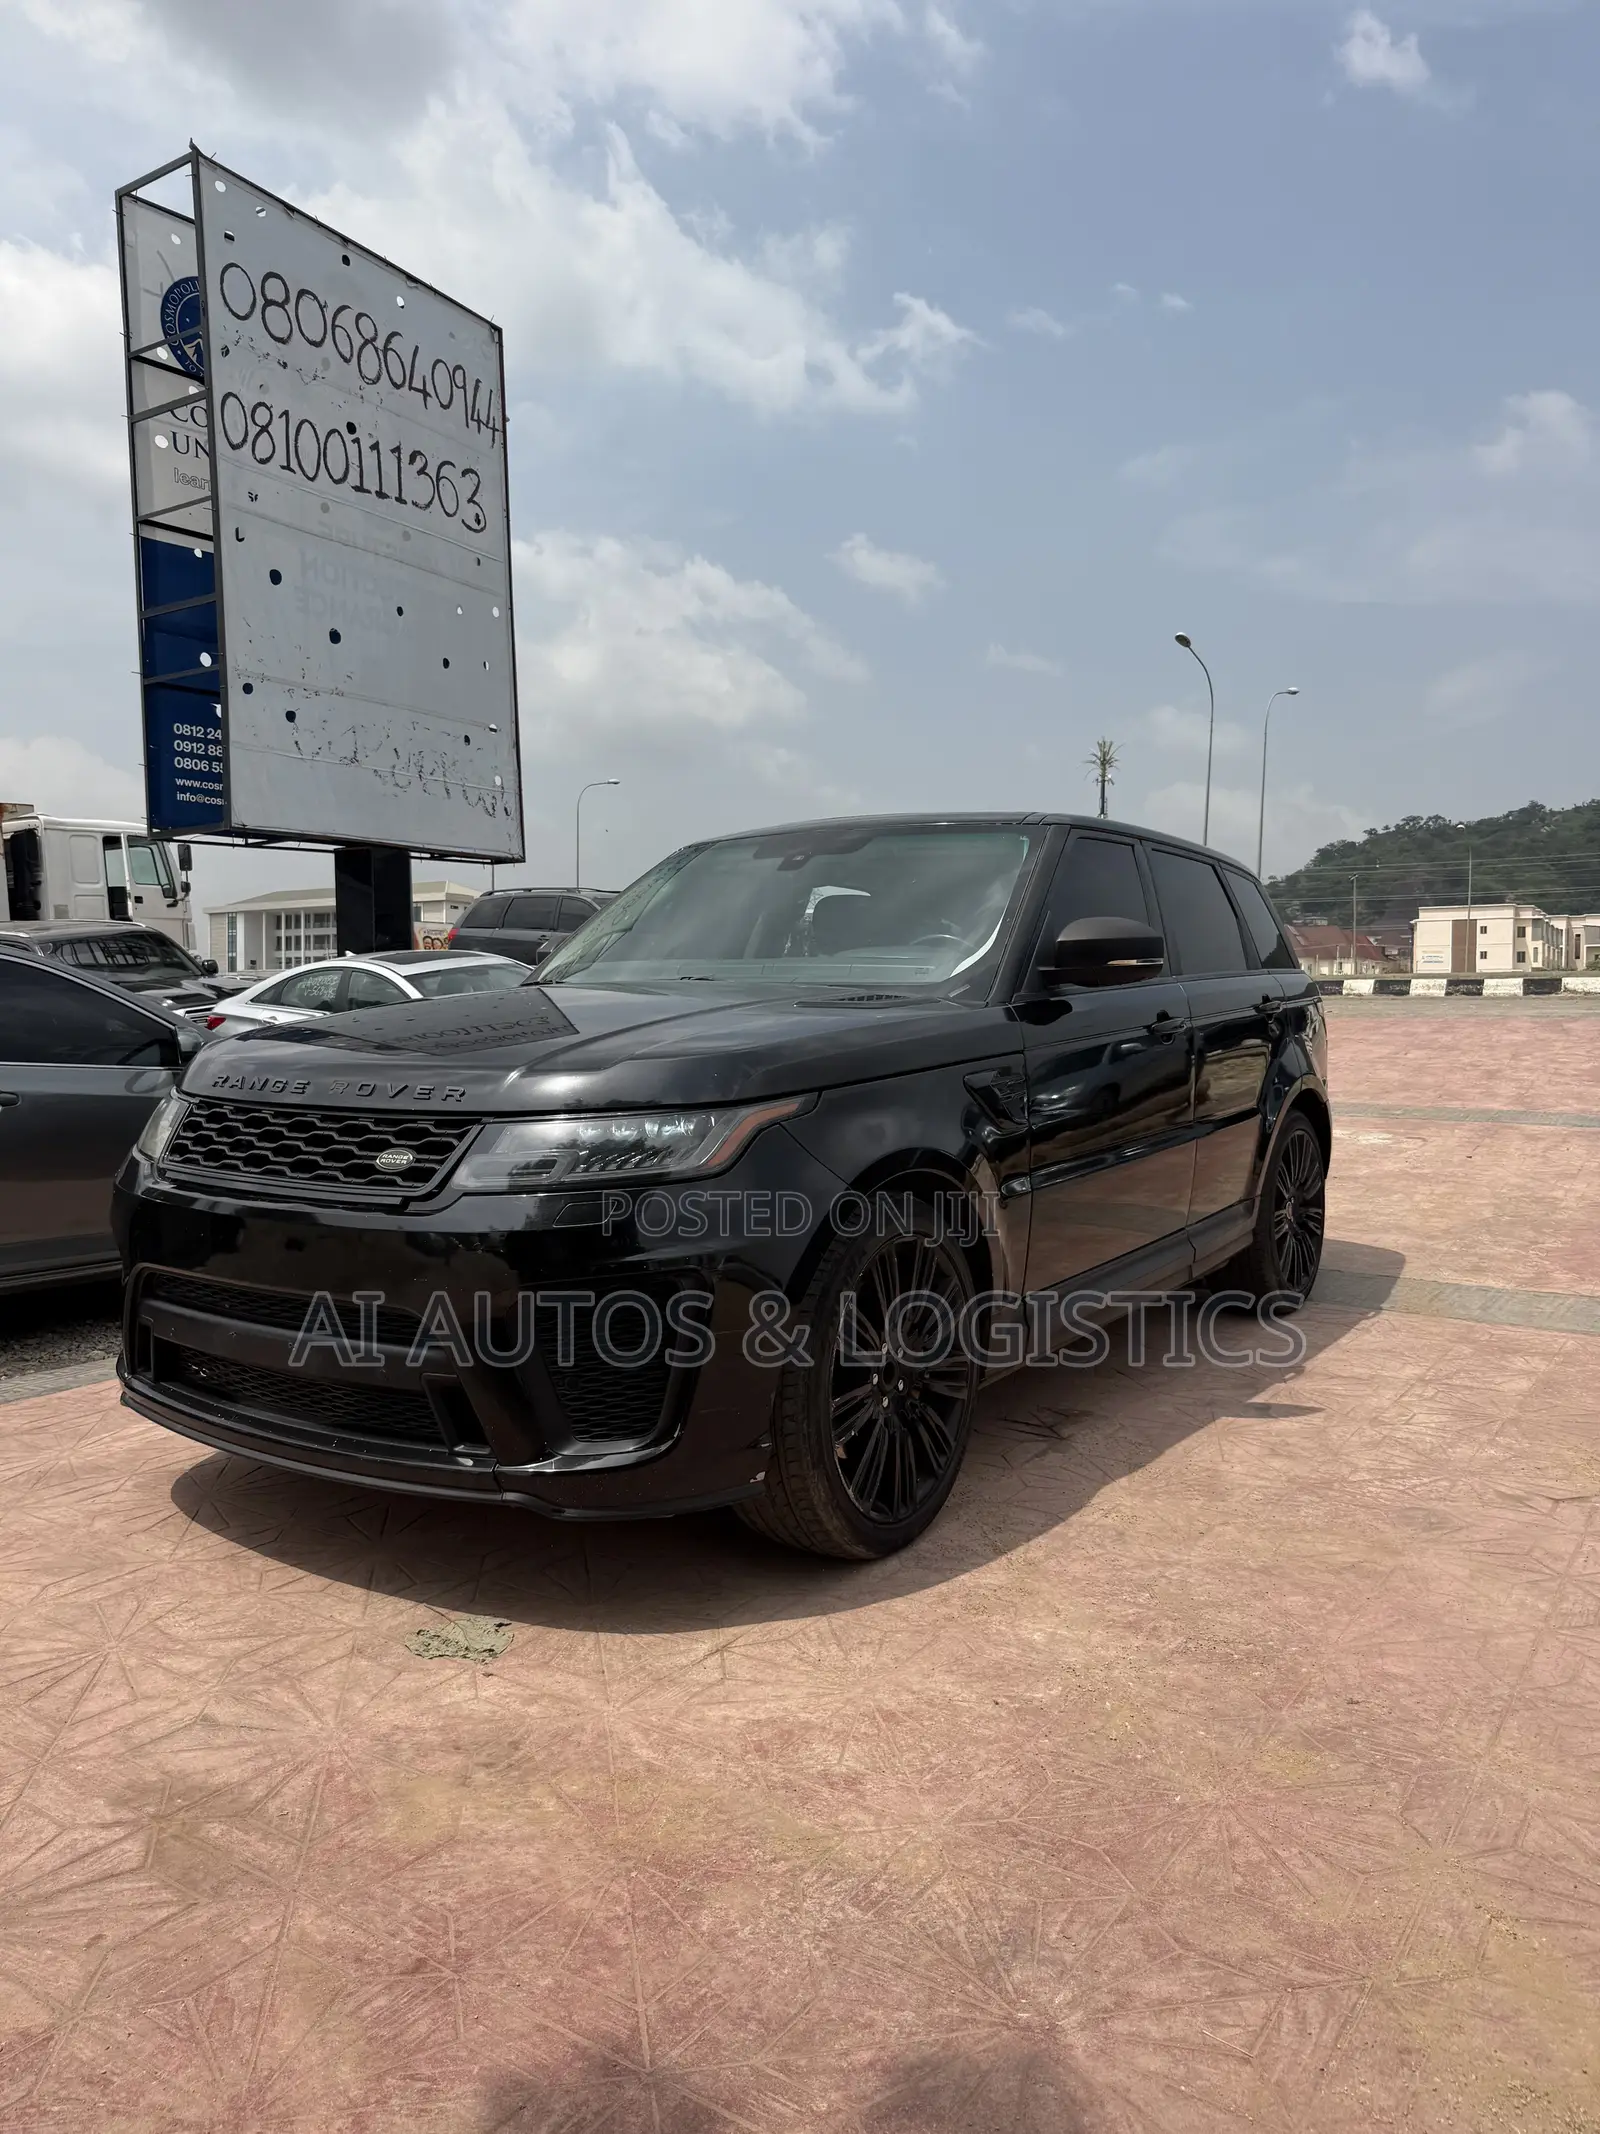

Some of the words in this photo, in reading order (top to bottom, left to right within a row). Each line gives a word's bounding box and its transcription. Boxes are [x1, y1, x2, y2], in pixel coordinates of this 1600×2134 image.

[219, 262, 504, 449] 08068640944
[220, 391, 487, 534] 08100111363
[173, 467, 212, 492] lear
[173, 723, 205, 738] 0812
[206, 728, 222, 740] 24
[174, 740, 205, 755] 0912
[174, 757, 209, 772] 0806
[176, 791, 225, 806] info@cos
[212, 1075, 311, 1095] RANGE
[329, 1079, 467, 1102] ROVER
